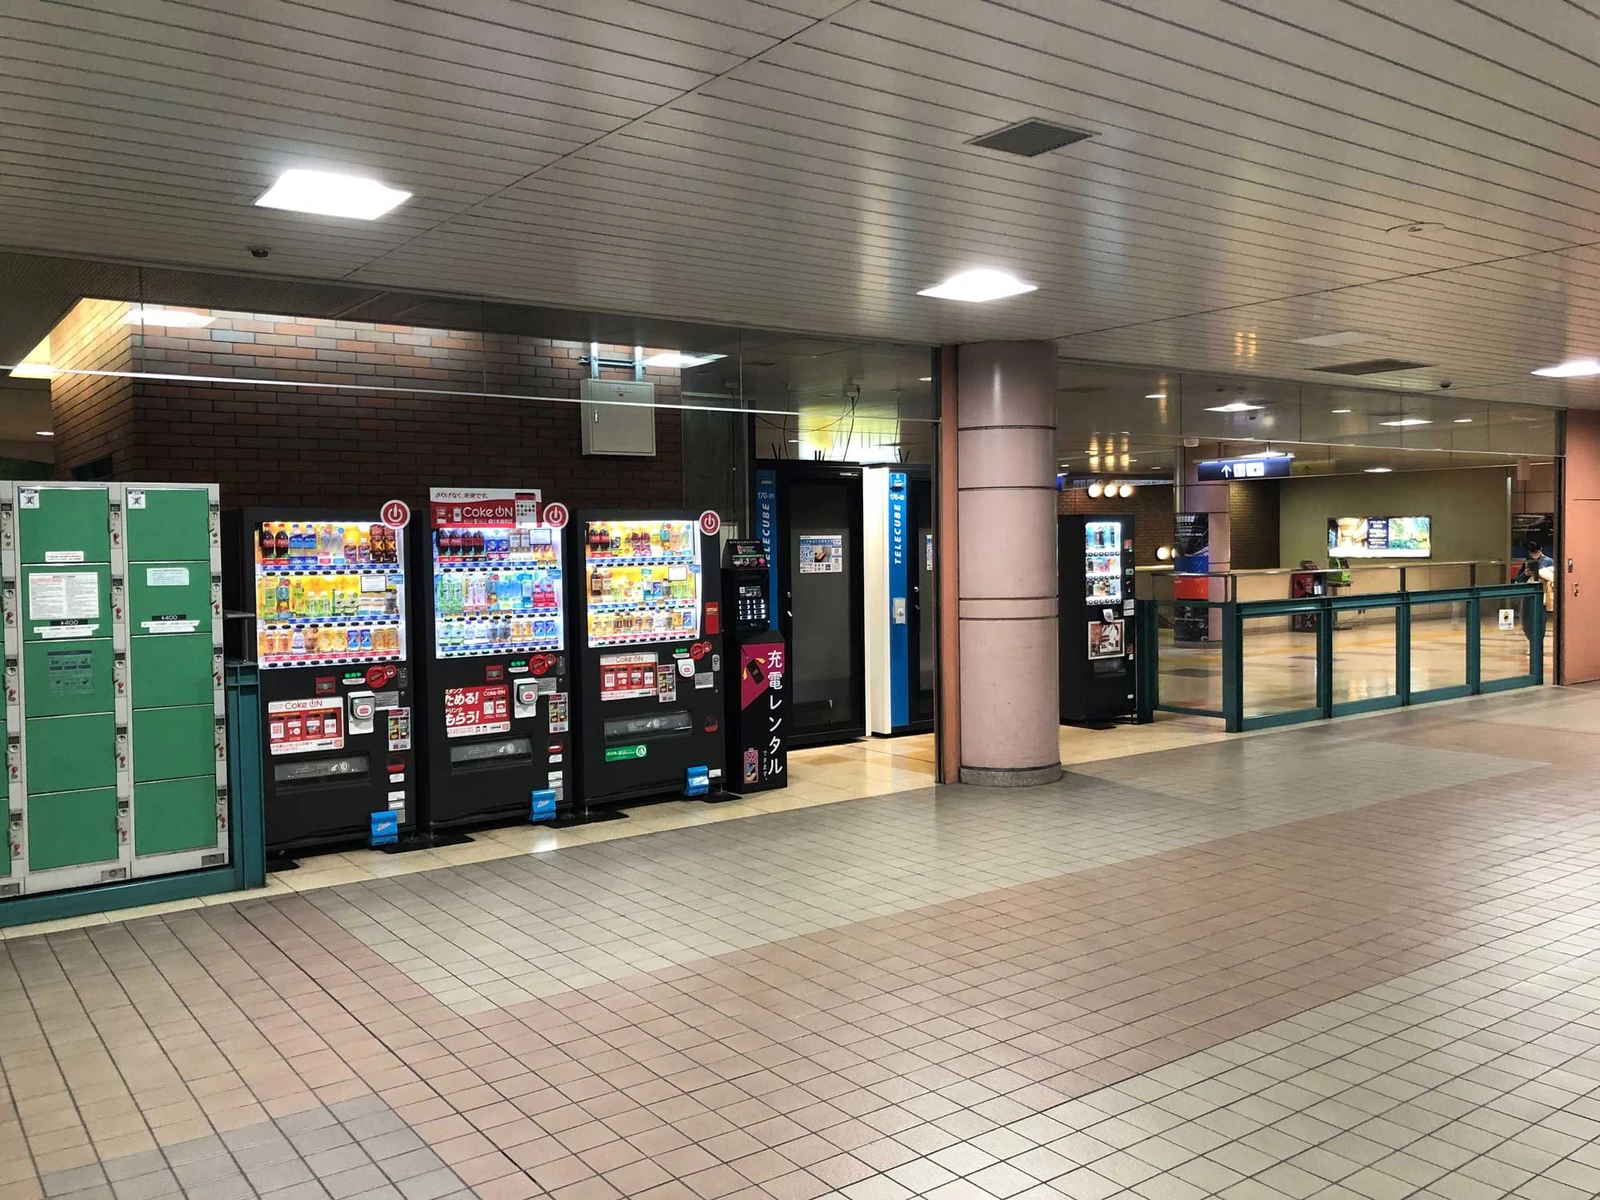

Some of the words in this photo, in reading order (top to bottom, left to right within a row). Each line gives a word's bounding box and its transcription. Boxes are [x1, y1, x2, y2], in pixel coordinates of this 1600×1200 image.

[462, 507, 494, 518] Coke
[761, 503, 771, 567] ELECUBE
[894, 504, 902, 564] TELECUBE
[615, 656, 633, 664] Coke
[284, 701, 308, 710] Coke
[445, 692, 479, 706] ためる!
[445, 711, 479, 726] もらう!
[767, 650, 783, 775] 充電レンタル
